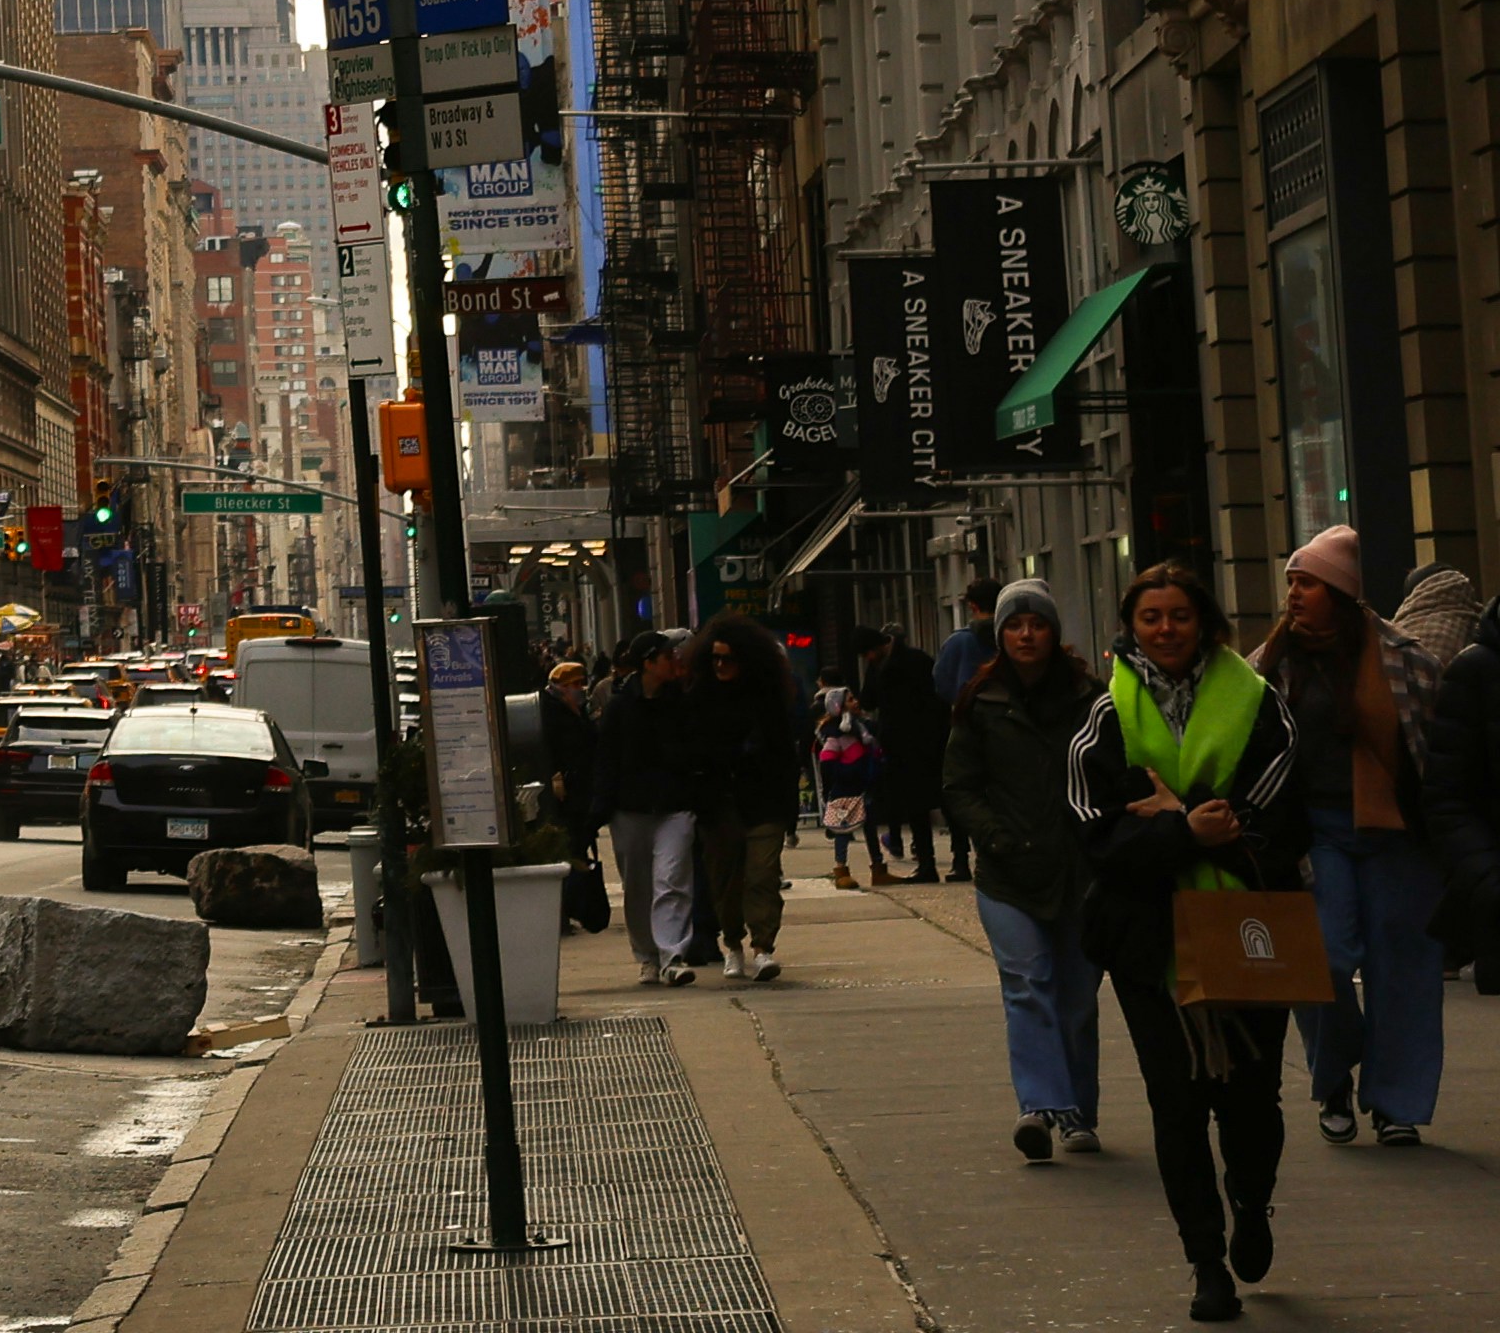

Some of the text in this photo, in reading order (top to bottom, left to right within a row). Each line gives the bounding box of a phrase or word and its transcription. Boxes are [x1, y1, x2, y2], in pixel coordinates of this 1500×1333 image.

[425, 47, 443, 65] Drop
[462, 41, 479, 57] Pick
[481, 40, 492, 56] Up
[494, 37, 512, 55] Only
[330, 107, 338, 132] 3
[430, 100, 495, 126] Broadway &
[432, 129, 467, 149] W 3 St
[331, 143, 367, 158] COMMERCIAL
[333, 157, 374, 173] VEHICLES ONLY
[469, 164, 529, 182] MAN
[471, 180, 531, 196] GROUP
[995, 194, 1024, 215] A
[450, 213, 559, 231] SINCE 1991
[341, 248, 351, 274] 2
[447, 287, 500, 311] Bond
[511, 286, 532, 310] St
[999, 227, 1037, 373] SNEAKER
[478, 350, 517, 361] BLUE
[479, 362, 518, 374] MAN
[479, 374, 519, 383] GROUP
[902, 269, 937, 489] A SNEAKER CITY
[465, 397, 537, 406] SINCE 1991
[214, 497, 291, 510] Bleecker St
[452, 660, 472, 670] Bus
[433, 672, 473, 683] Arrivals
